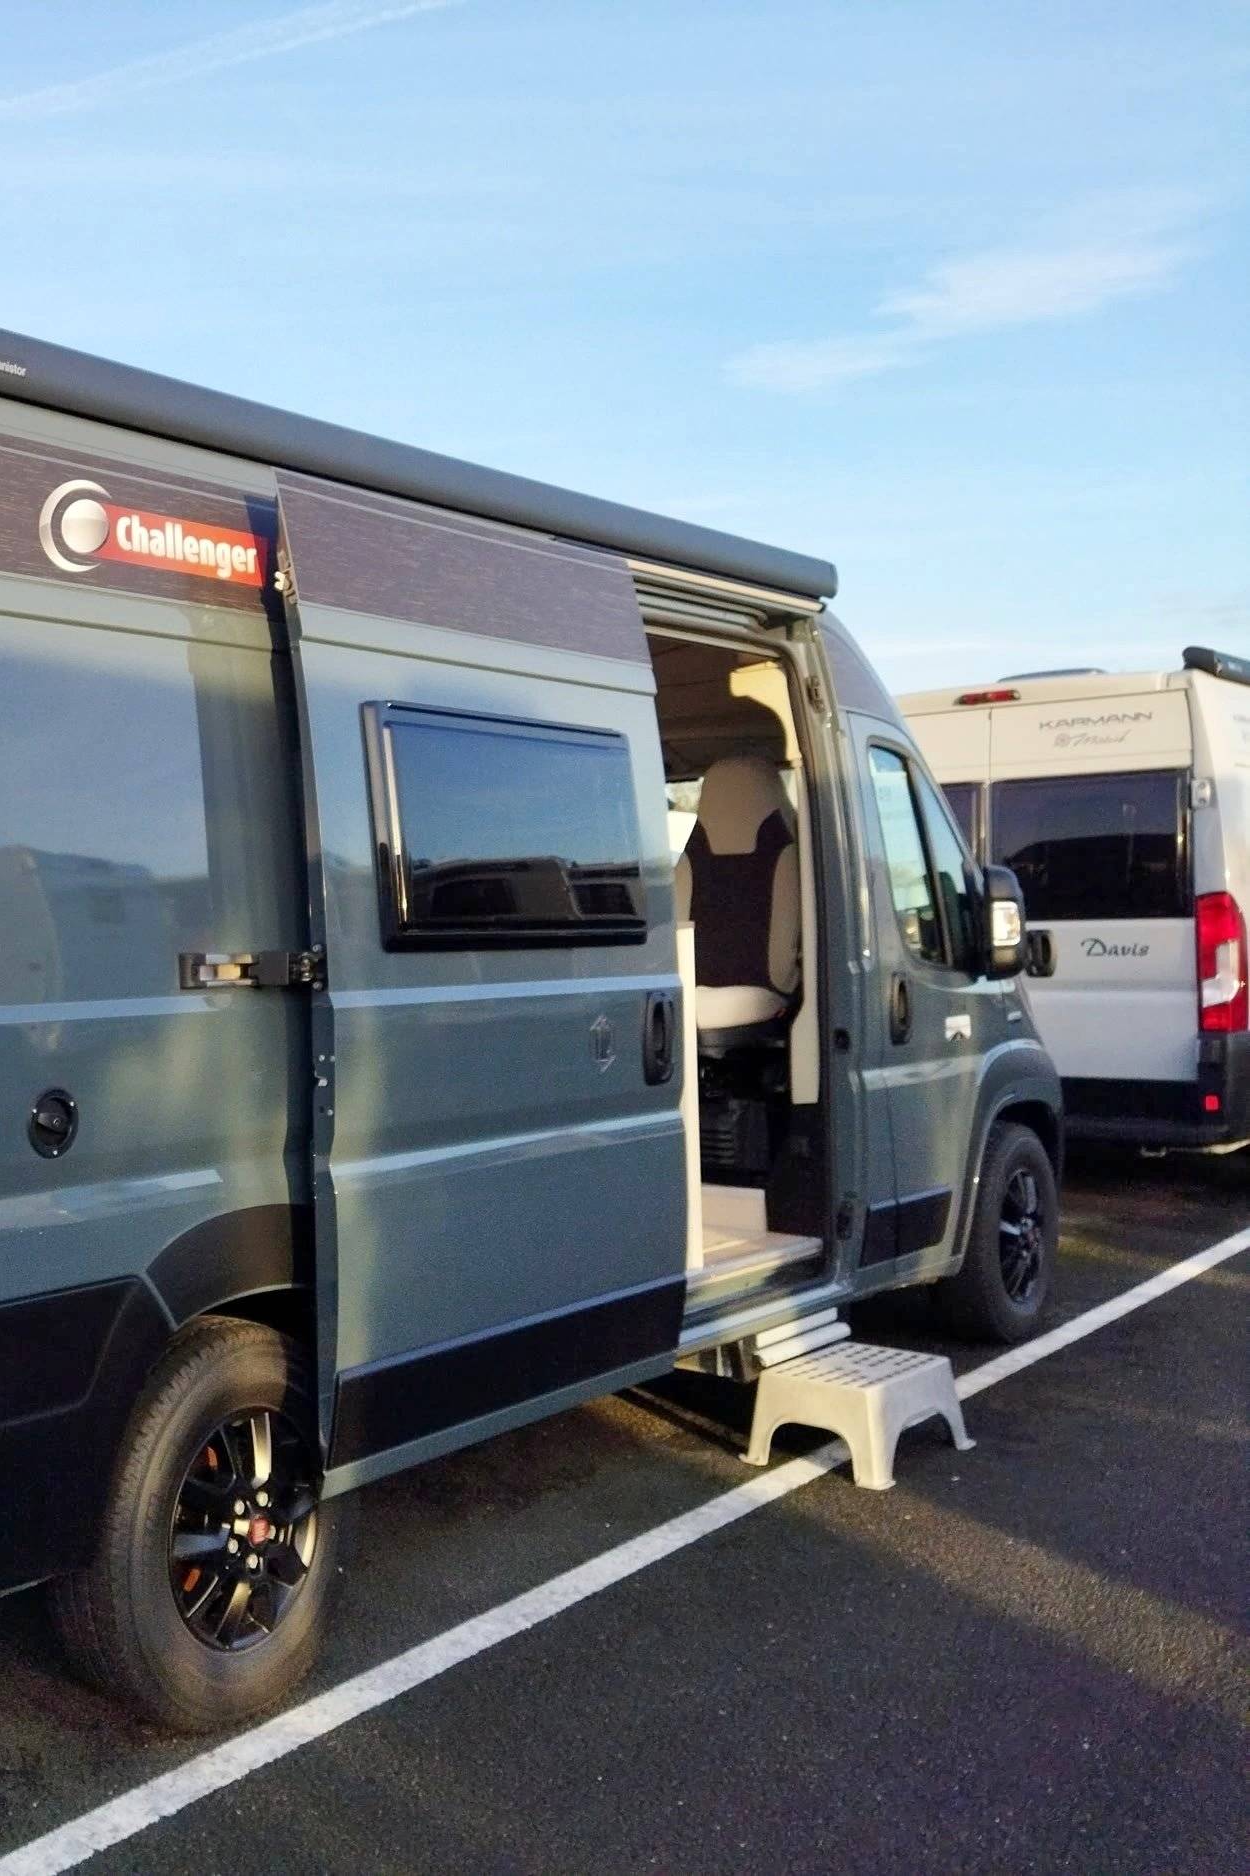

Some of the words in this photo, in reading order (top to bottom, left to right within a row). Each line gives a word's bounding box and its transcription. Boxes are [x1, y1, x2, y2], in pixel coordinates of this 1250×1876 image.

[116, 515, 257, 578] Challenger
[1039, 712, 1153, 730] KARMANN
[1080, 937, 1150, 956] Davis
